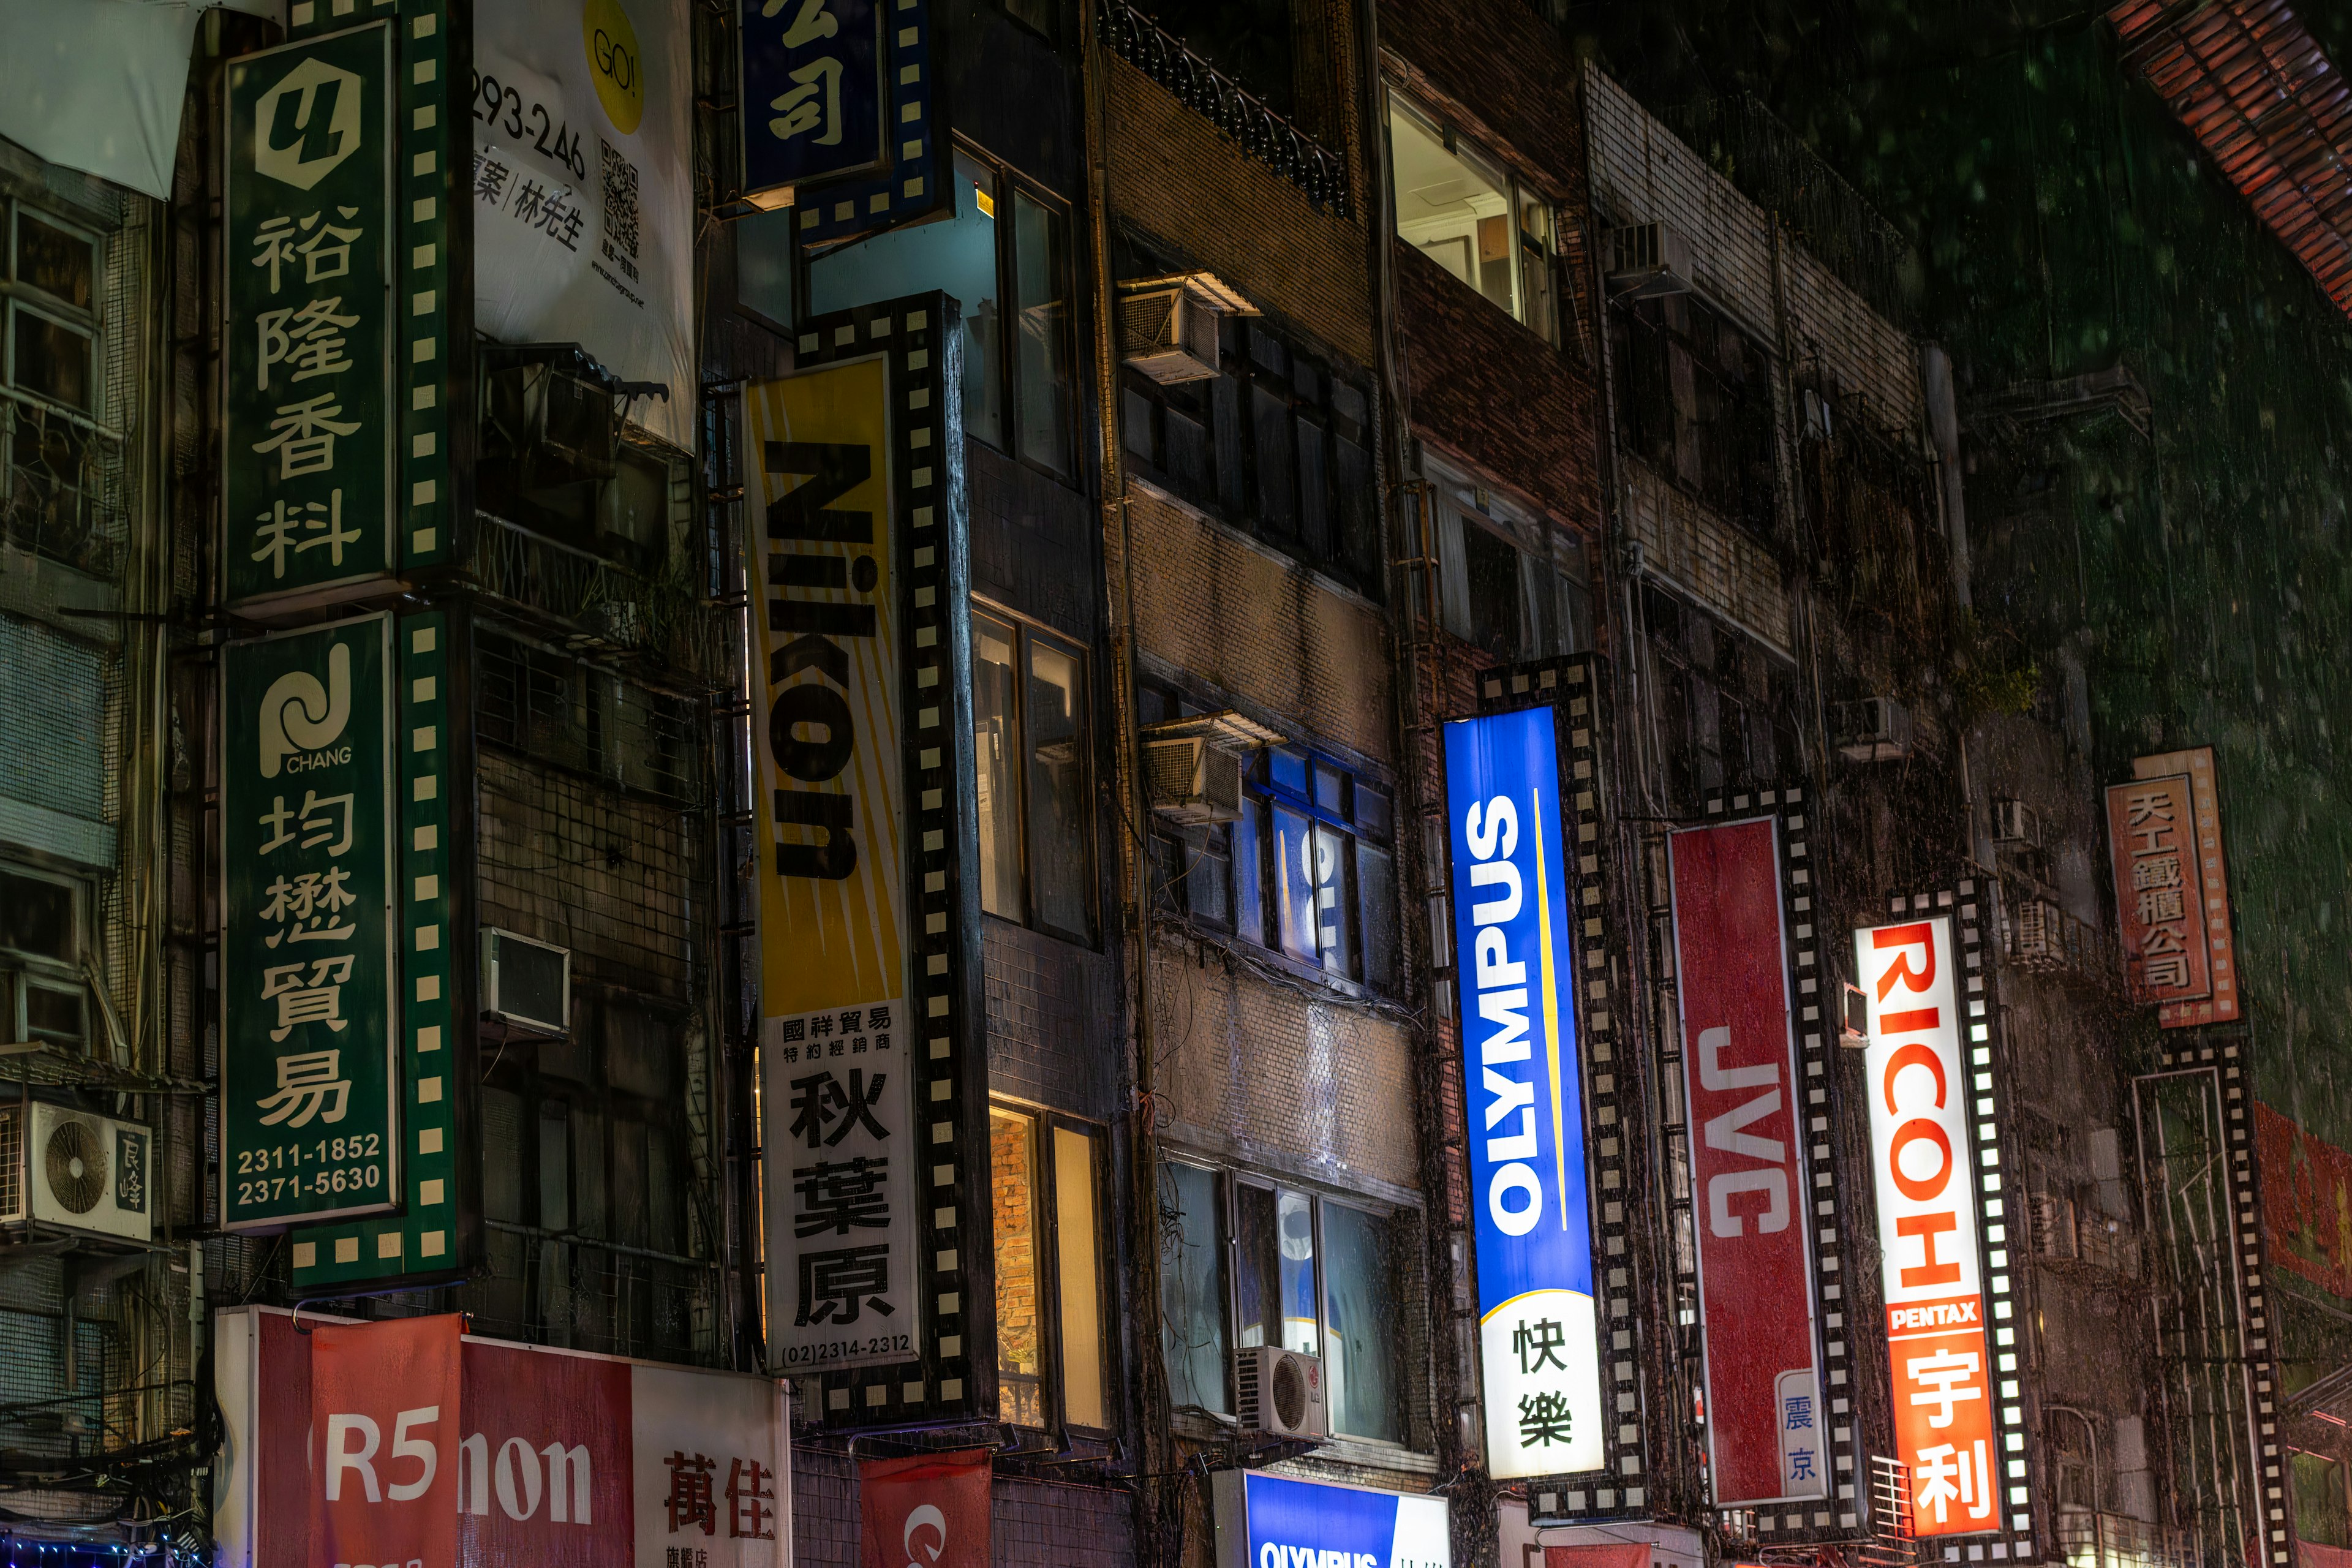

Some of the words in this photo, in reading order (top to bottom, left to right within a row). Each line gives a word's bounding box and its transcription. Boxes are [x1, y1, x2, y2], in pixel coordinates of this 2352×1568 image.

[594, 28, 636, 98] GO!
[251, 205, 363, 579] 裕隆香料
[764, 440, 878, 880] Nikon
[286, 747, 352, 774] CHANG
[256, 790, 356, 1128] 均懋貿易
[783, 1006, 891, 1043] 國祥貿易
[783, 1033, 890, 1063] 特約經銷商
[1466, 794, 1543, 1236] OLYMPUS
[1698, 1026, 1790, 1237] JVC
[1872, 922, 1961, 1287] RICOH
[238, 1133, 380, 1174] 2311-1852
[238, 1164, 380, 1205] 2371-5630
[790, 1068, 895, 1327] 秋葉原
[781, 1335, 910, 1366] (02)2314-2312
[1891, 1302, 1978, 1330] PENTAX
[1513, 1317, 1572, 1448] 快樂
[325, 1405, 440, 1503] R5
[1785, 1396, 1816, 1481] 震京
[1906, 1348, 1992, 1524] 宇利
[663, 1450, 775, 1540] 萬佳
